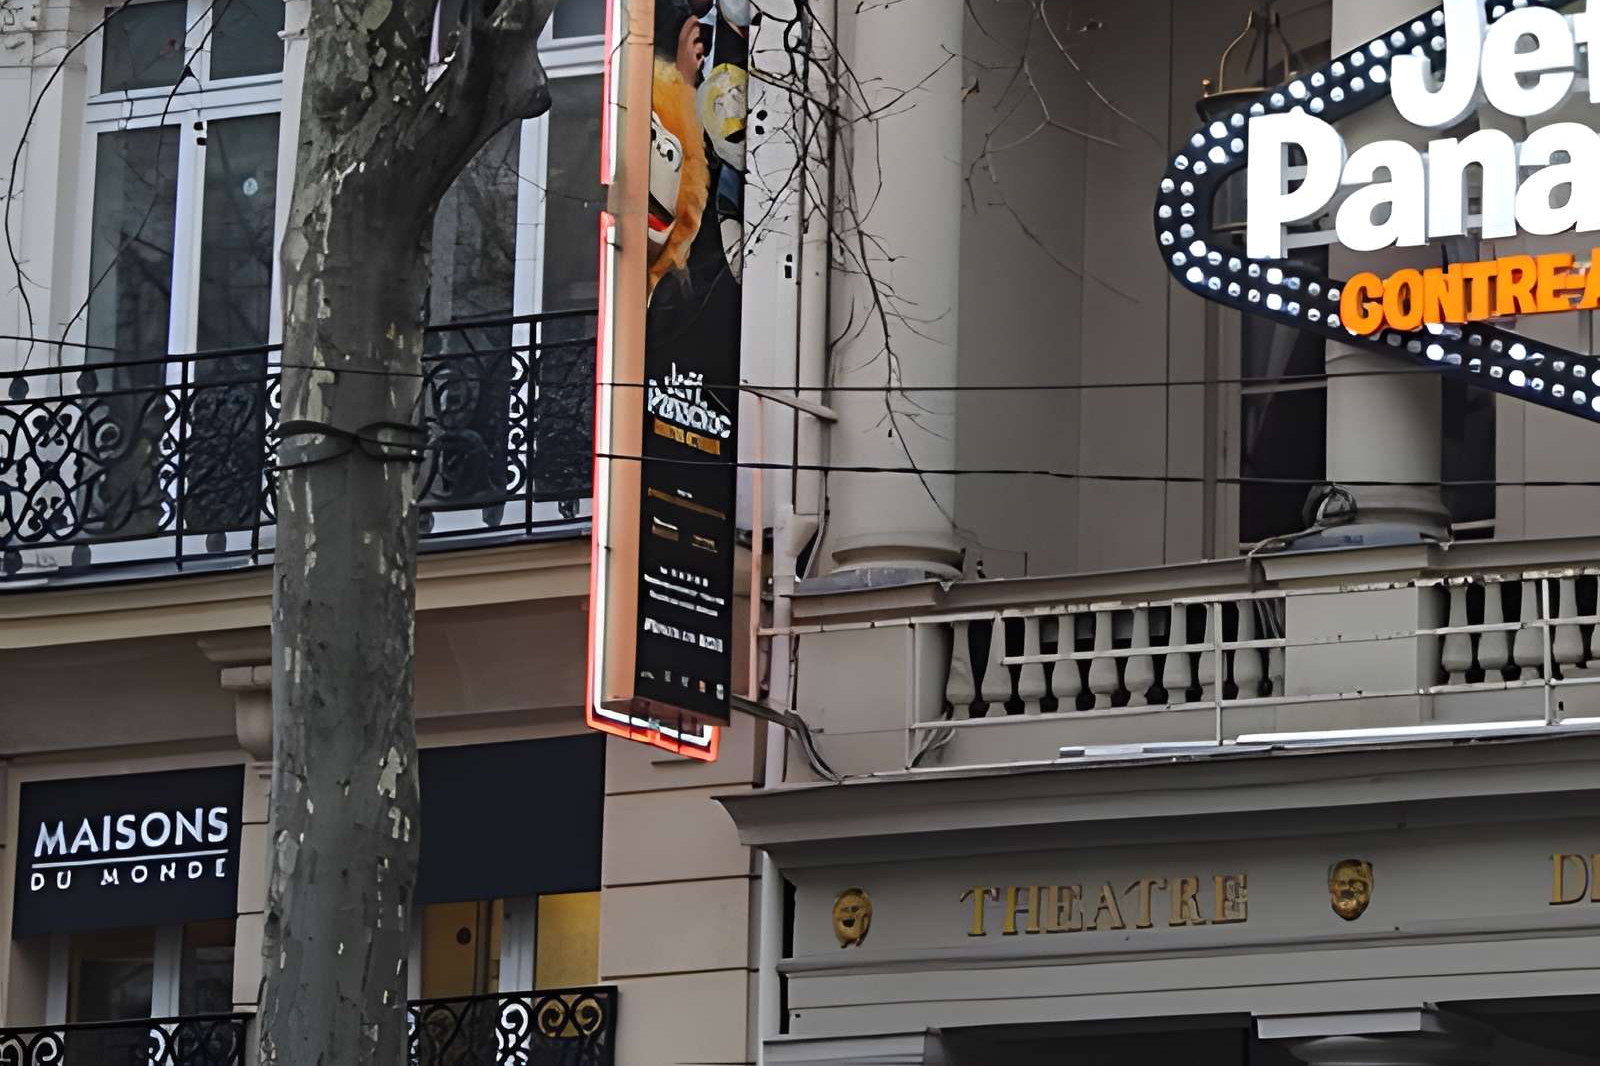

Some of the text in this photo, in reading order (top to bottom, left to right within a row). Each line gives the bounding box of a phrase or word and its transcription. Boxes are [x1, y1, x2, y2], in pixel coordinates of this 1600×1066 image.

[34, 806, 228, 857] MAISONS
[30, 858, 226, 891] DU MONDE
[960, 873, 1249, 937] THEATRE
